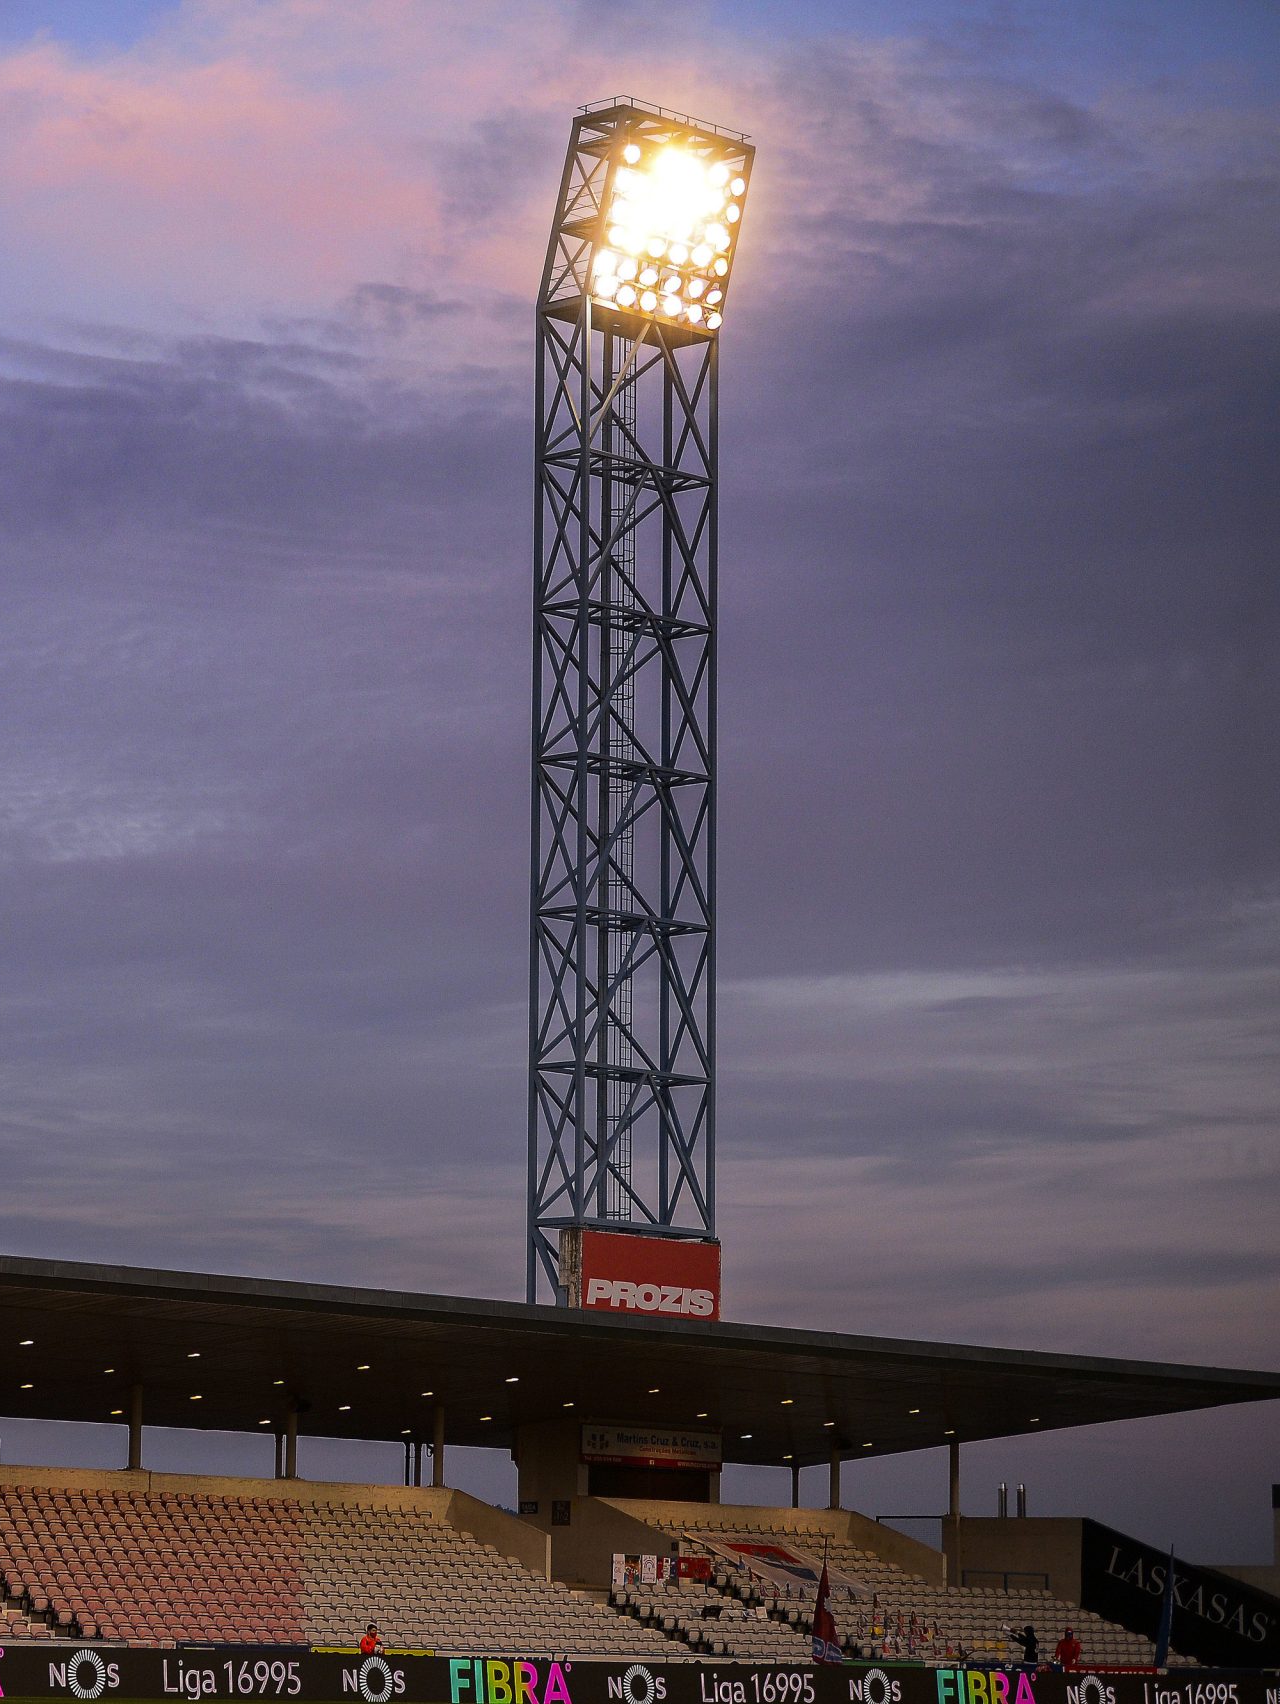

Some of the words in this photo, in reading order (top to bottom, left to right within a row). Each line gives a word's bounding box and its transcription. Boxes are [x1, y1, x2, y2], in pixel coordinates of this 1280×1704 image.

[586, 1278, 714, 1316] PROZIS
[617, 1432, 649, 1445] Martins
[651, 1435, 669, 1445] Cruz
[672, 1437, 679, 1446] &
[1103, 1545, 1270, 1642] LASKASAS
[48, 1649, 120, 1699] NOS
[163, 1659, 217, 1700] Liga
[223, 1661, 302, 1695] 16995
[342, 1656, 407, 1703] NOS
[449, 1659, 571, 1704] FIBRA
[608, 1664, 667, 1704] NOS
[700, 1673, 746, 1704] Liga
[751, 1673, 815, 1704] 16995
[849, 1668, 902, 1704] NOS
[936, 1670, 1037, 1704] FIBRA
[1066, 1675, 1116, 1704] NOS
[1185, 1683, 1240, 1704] 16995
